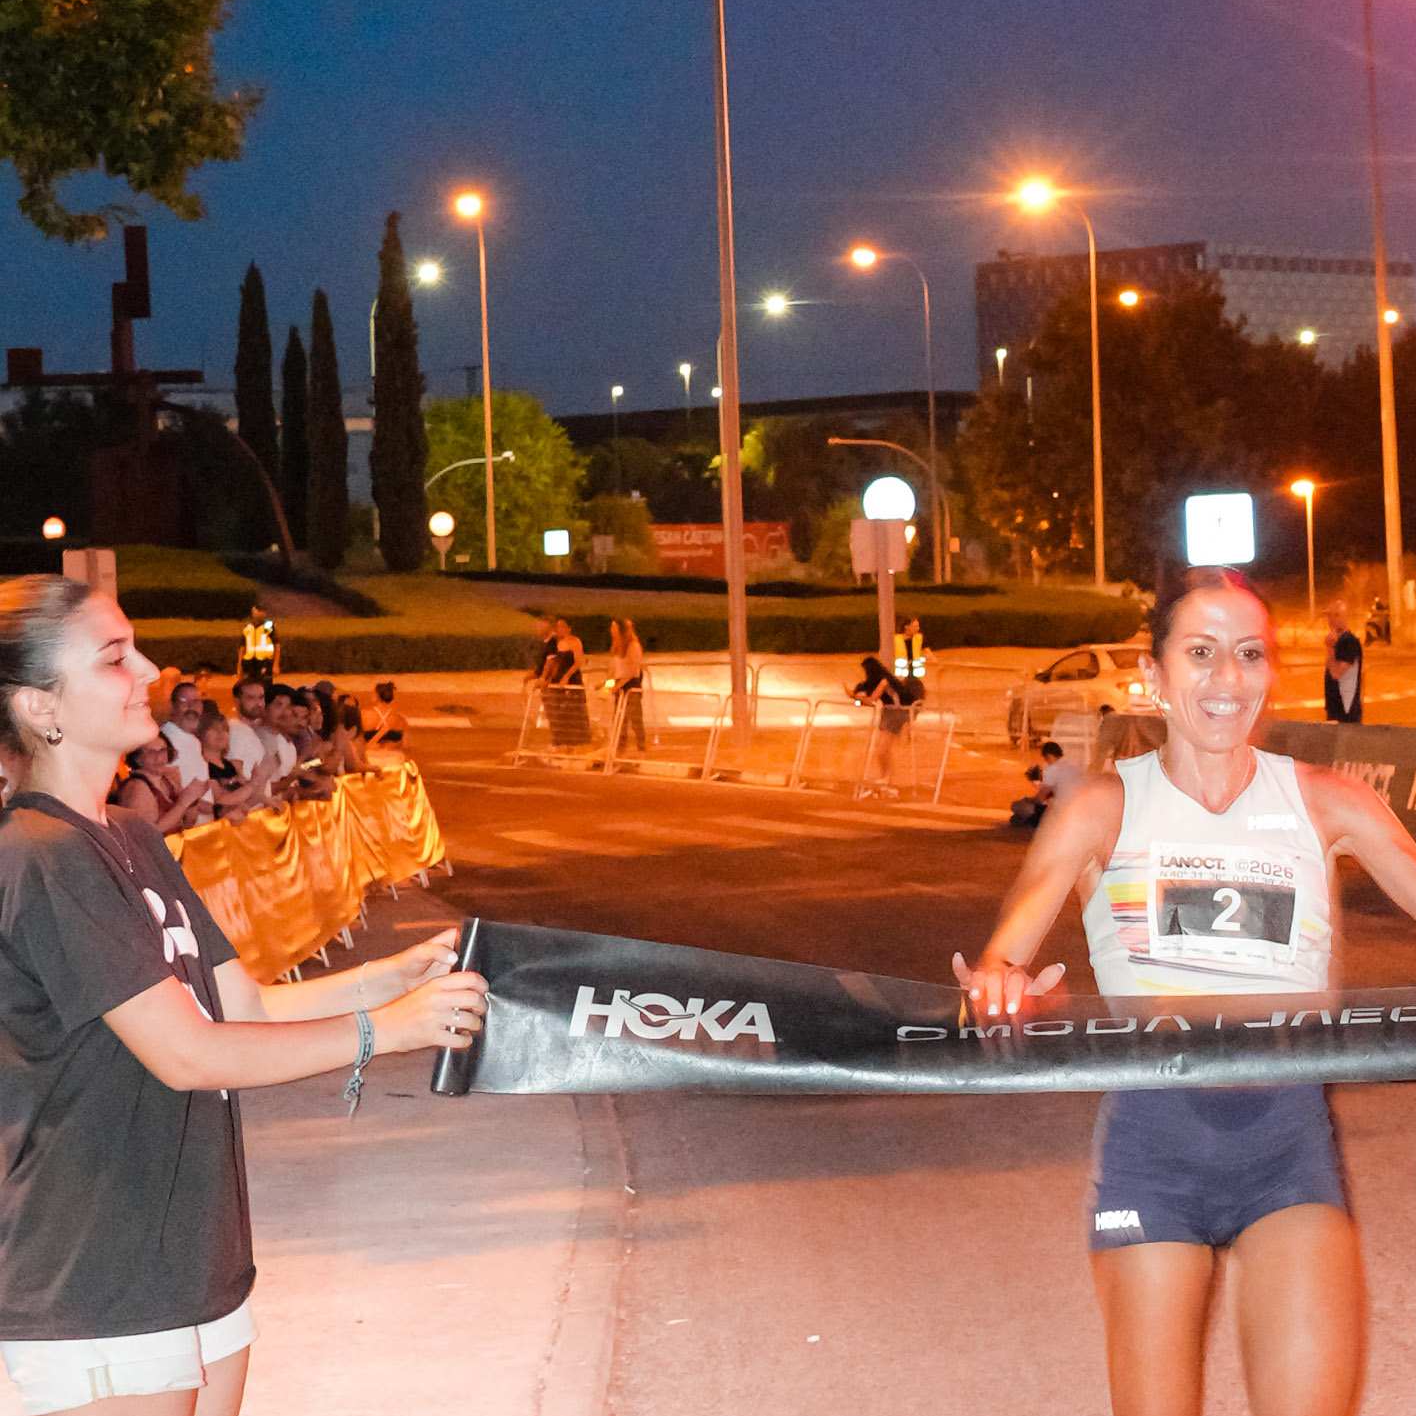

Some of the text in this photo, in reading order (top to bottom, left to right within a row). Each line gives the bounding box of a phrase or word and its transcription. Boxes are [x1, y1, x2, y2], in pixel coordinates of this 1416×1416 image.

[1211, 887, 1242, 932] 2
[568, 985, 777, 1043] HOKA
[896, 1014, 1193, 1042] OMODA
